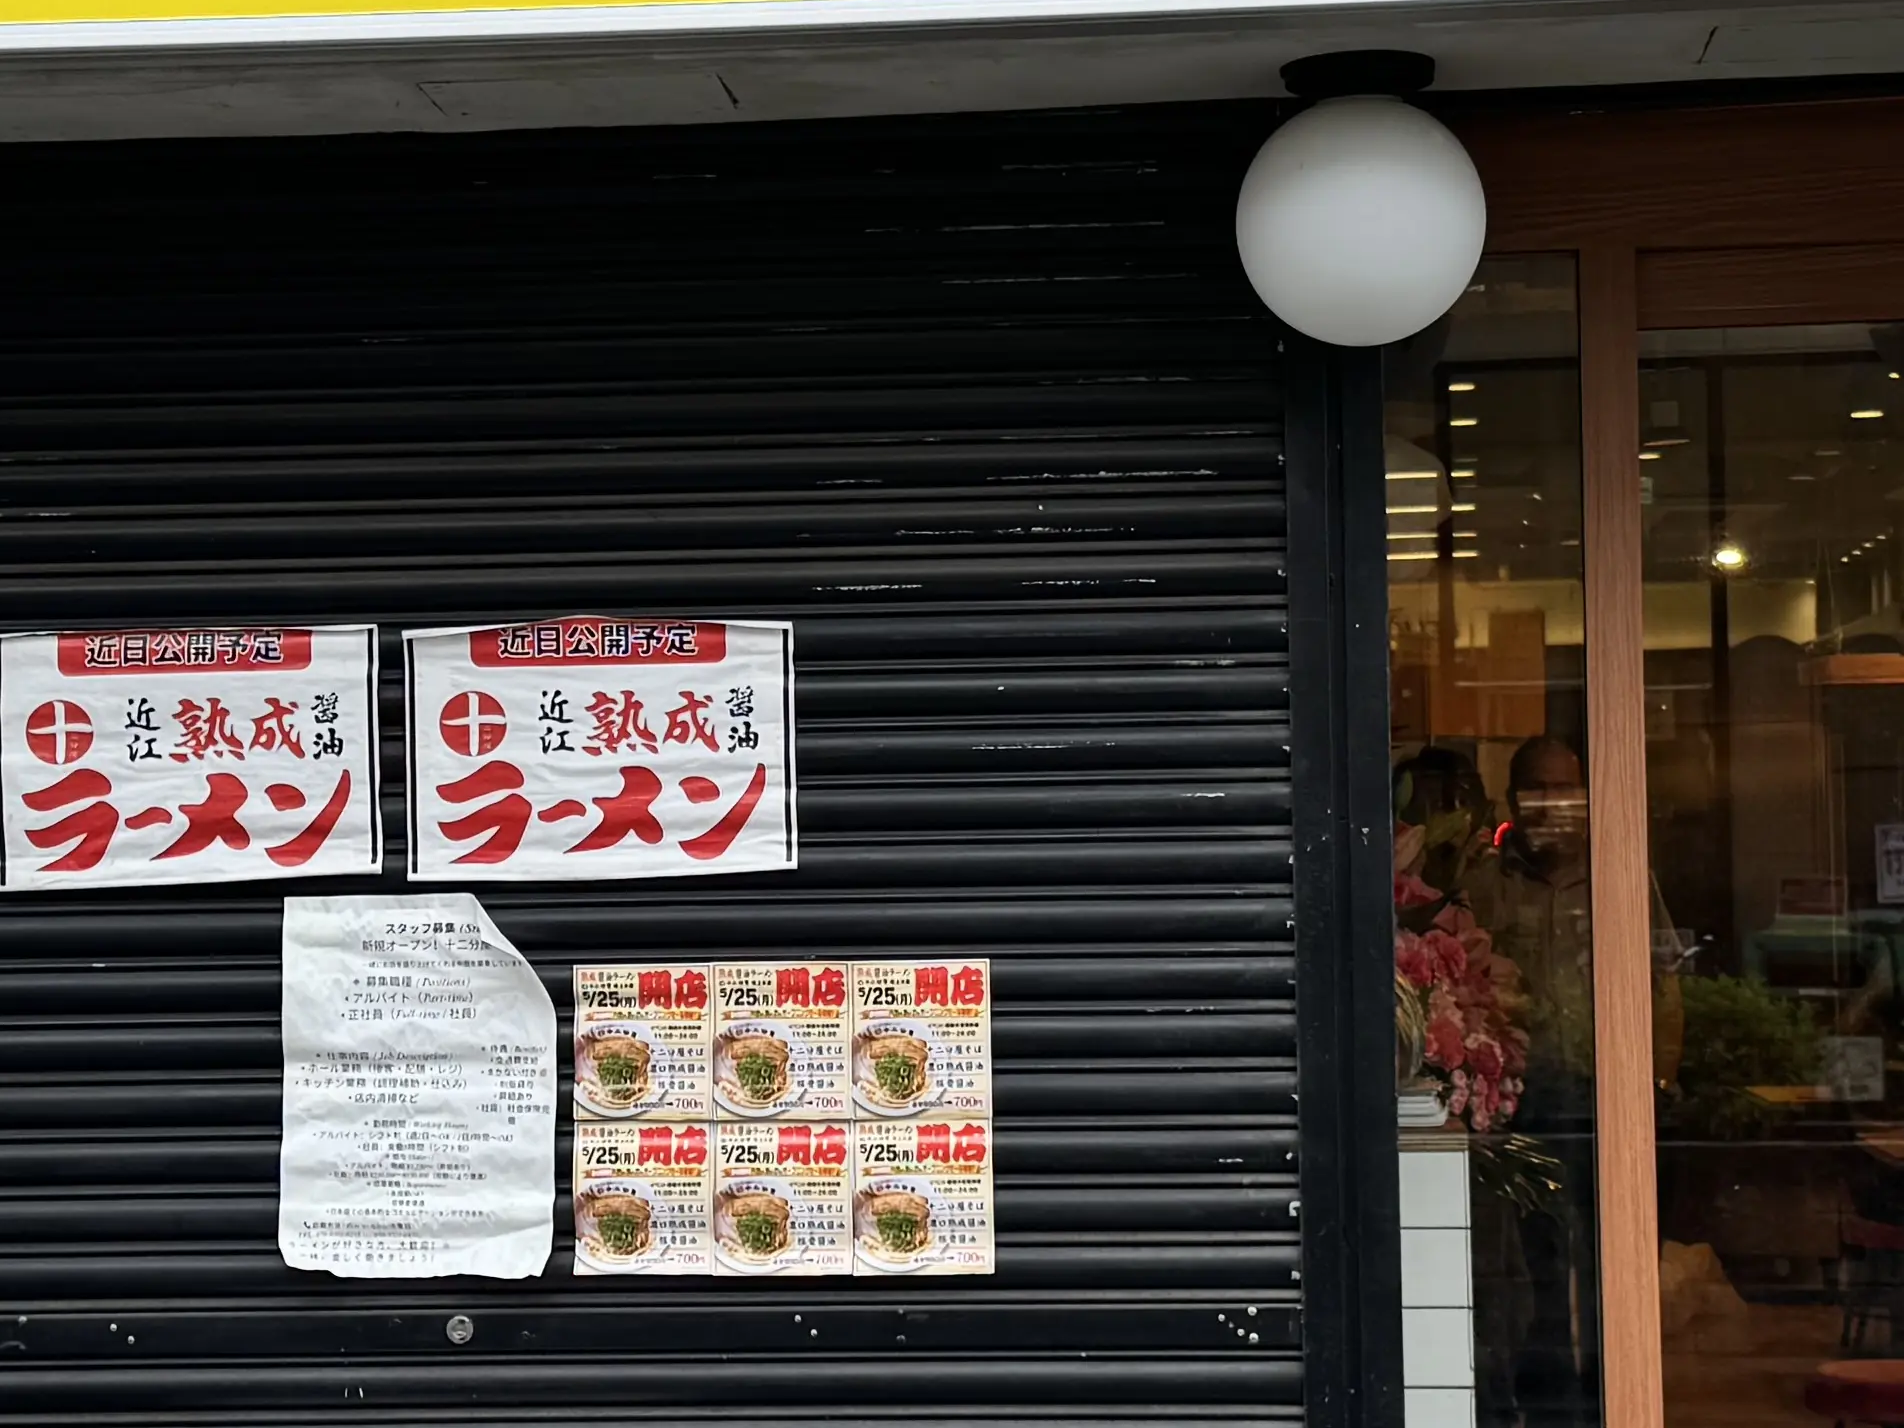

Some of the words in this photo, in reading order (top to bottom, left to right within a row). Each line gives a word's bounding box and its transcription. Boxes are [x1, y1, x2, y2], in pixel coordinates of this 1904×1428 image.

[84, 632, 284, 668] 近日公開予定
[498, 623, 699, 659] 近日公開予定
[124, 697, 163, 762] 近江
[169, 697, 305, 763] 熟成
[309, 692, 345, 760] 醤油
[538, 689, 576, 754] 近江
[581, 690, 720, 756] 熟成
[724, 685, 760, 753] 醤油
[21, 768, 352, 872] ラーメン
[436, 760, 766, 864] ラーメン
[353, 993, 410, 1003] アルバイト
[638, 970, 708, 1010] 開店
[776, 967, 845, 1008] 開店
[914, 966, 985, 1007] 開店
[638, 1125, 707, 1166] 開店
[777, 1125, 846, 1165] 開店
[916, 1123, 987, 1163] 開店
